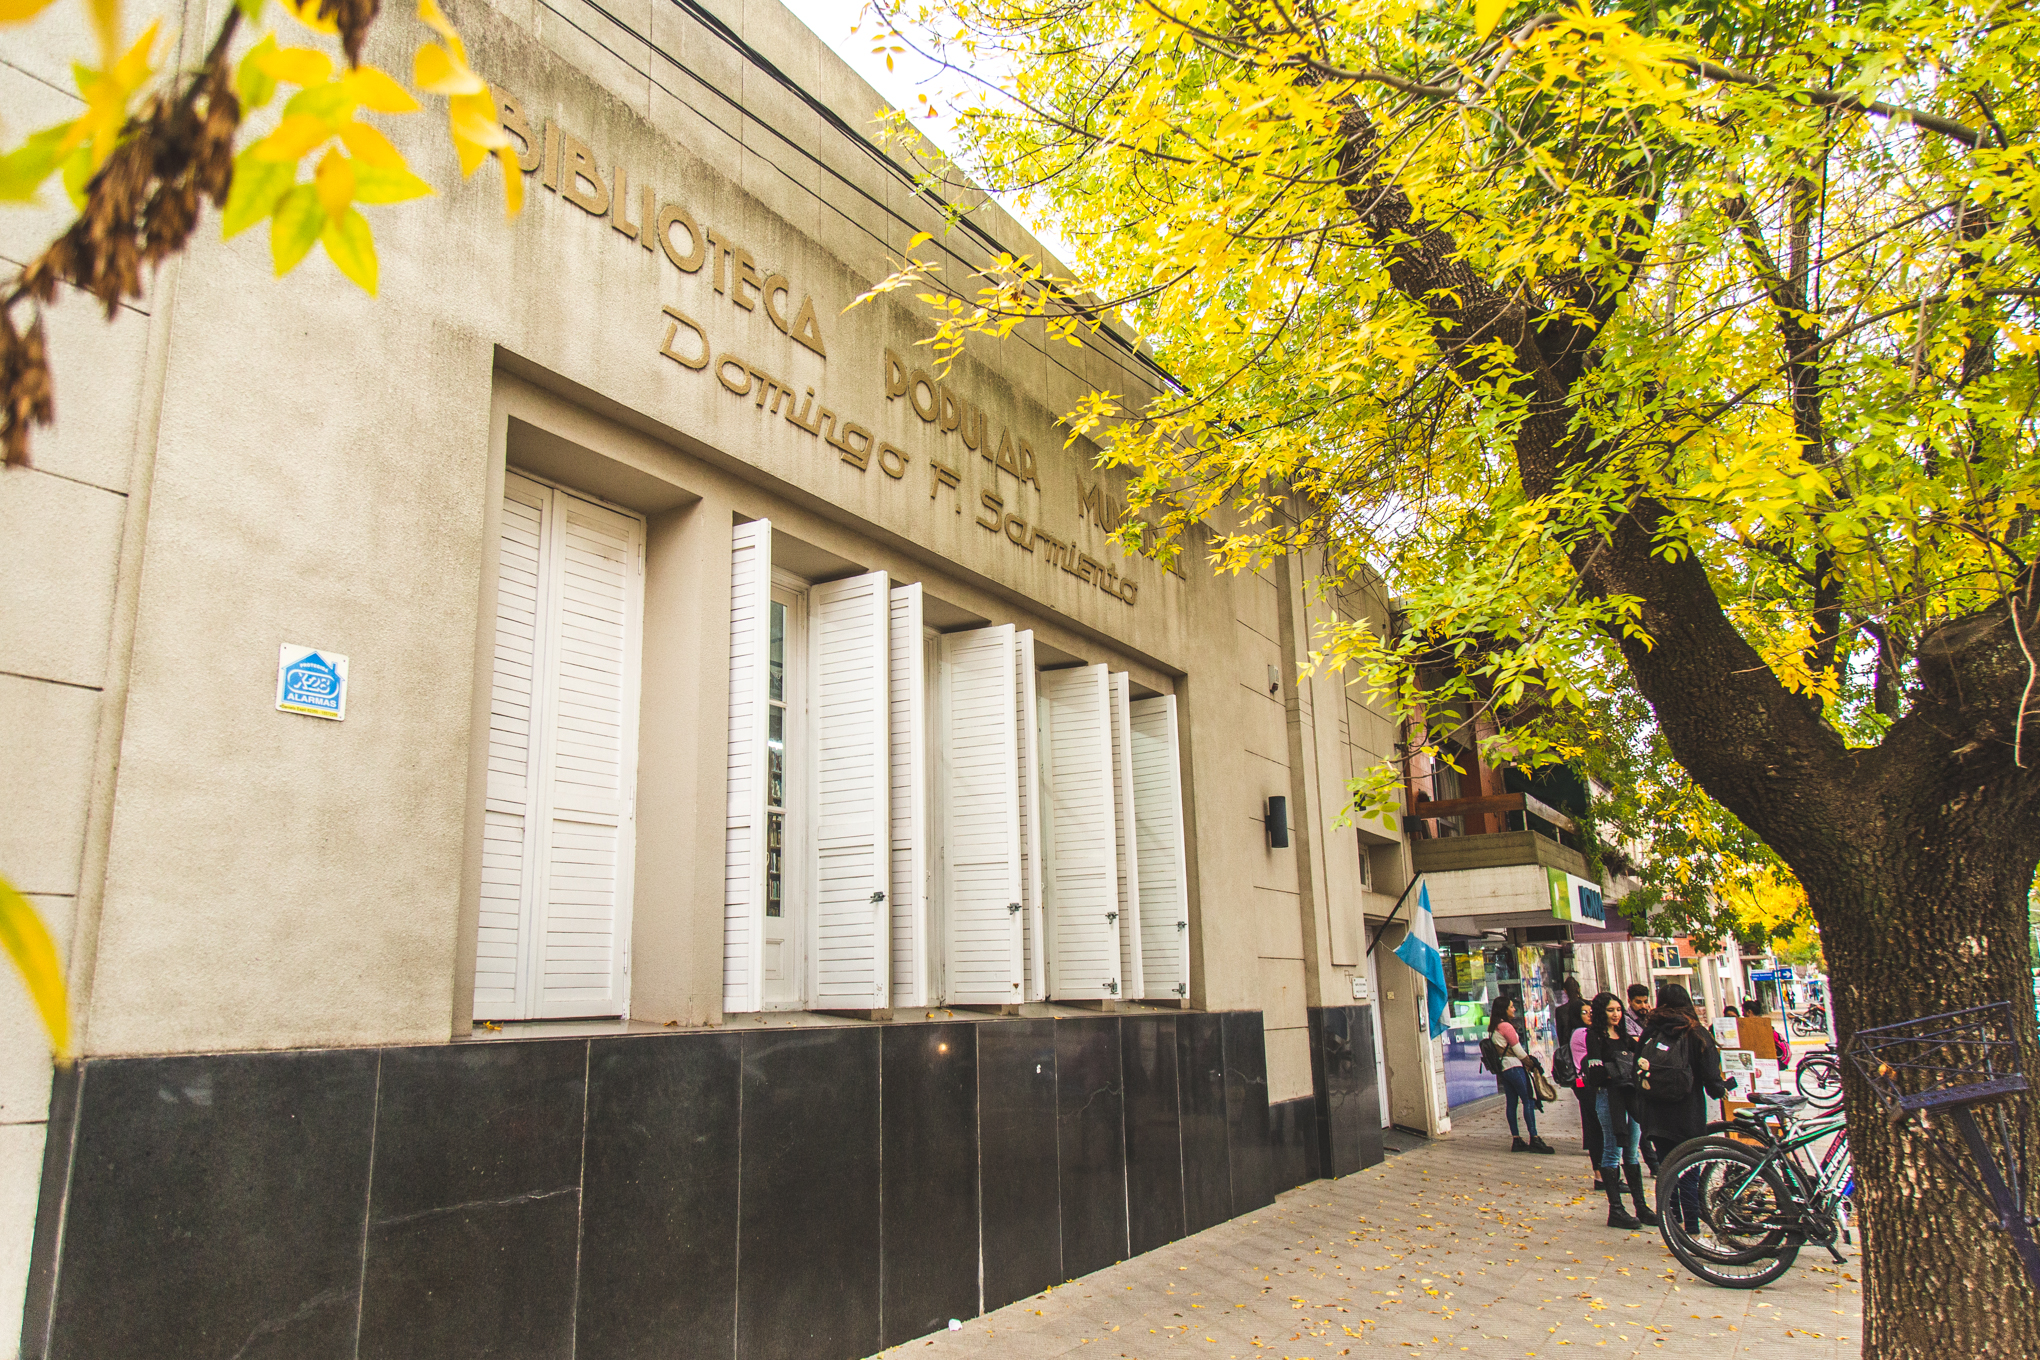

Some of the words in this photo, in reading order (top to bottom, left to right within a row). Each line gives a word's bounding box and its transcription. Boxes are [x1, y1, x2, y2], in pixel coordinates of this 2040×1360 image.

[490, 82, 827, 359] BIBLIOTECA
[885, 347, 1041, 492] POPULAR
[660, 304, 909, 479] Domingo
[930, 458, 962, 515] F.
[976, 488, 1138, 606] Sarmiento
[287, 692, 337, 708] ALARMAS
